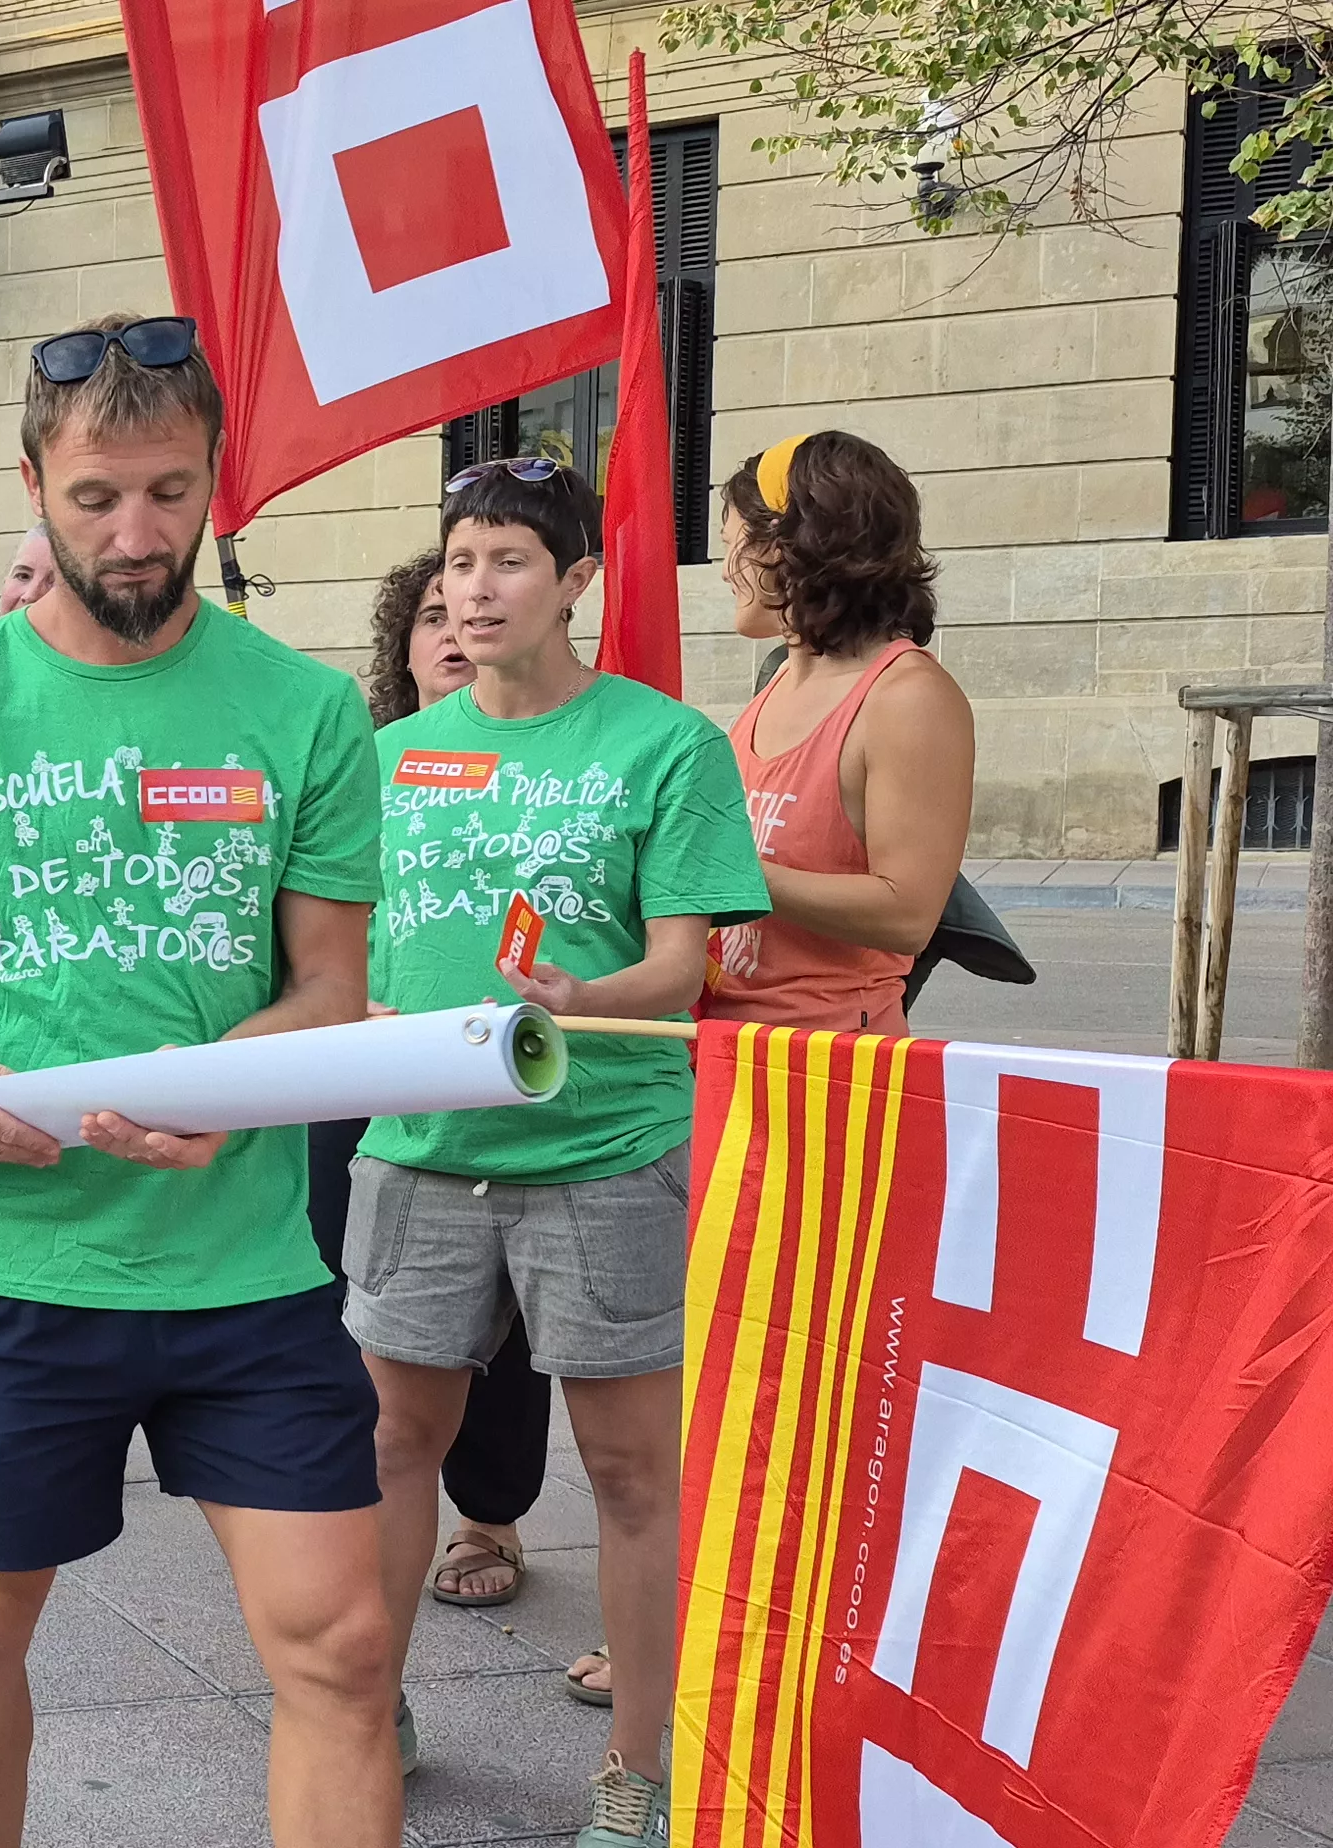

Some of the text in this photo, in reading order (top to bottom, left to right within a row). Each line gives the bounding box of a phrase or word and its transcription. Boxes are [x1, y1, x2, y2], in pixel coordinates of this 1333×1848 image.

[400, 760, 463, 776] CCOO
[511, 769, 630, 808] PÚBLICA:
[148, 787, 226, 804] CCOO
[397, 830, 591, 876] DE TOD@S
[8, 854, 244, 899] DE TOD@S
[387, 890, 474, 937] PARA
[128, 924, 257, 971] TOD@S
[834, 1296, 906, 1685] www.aragon.ccoo.es
